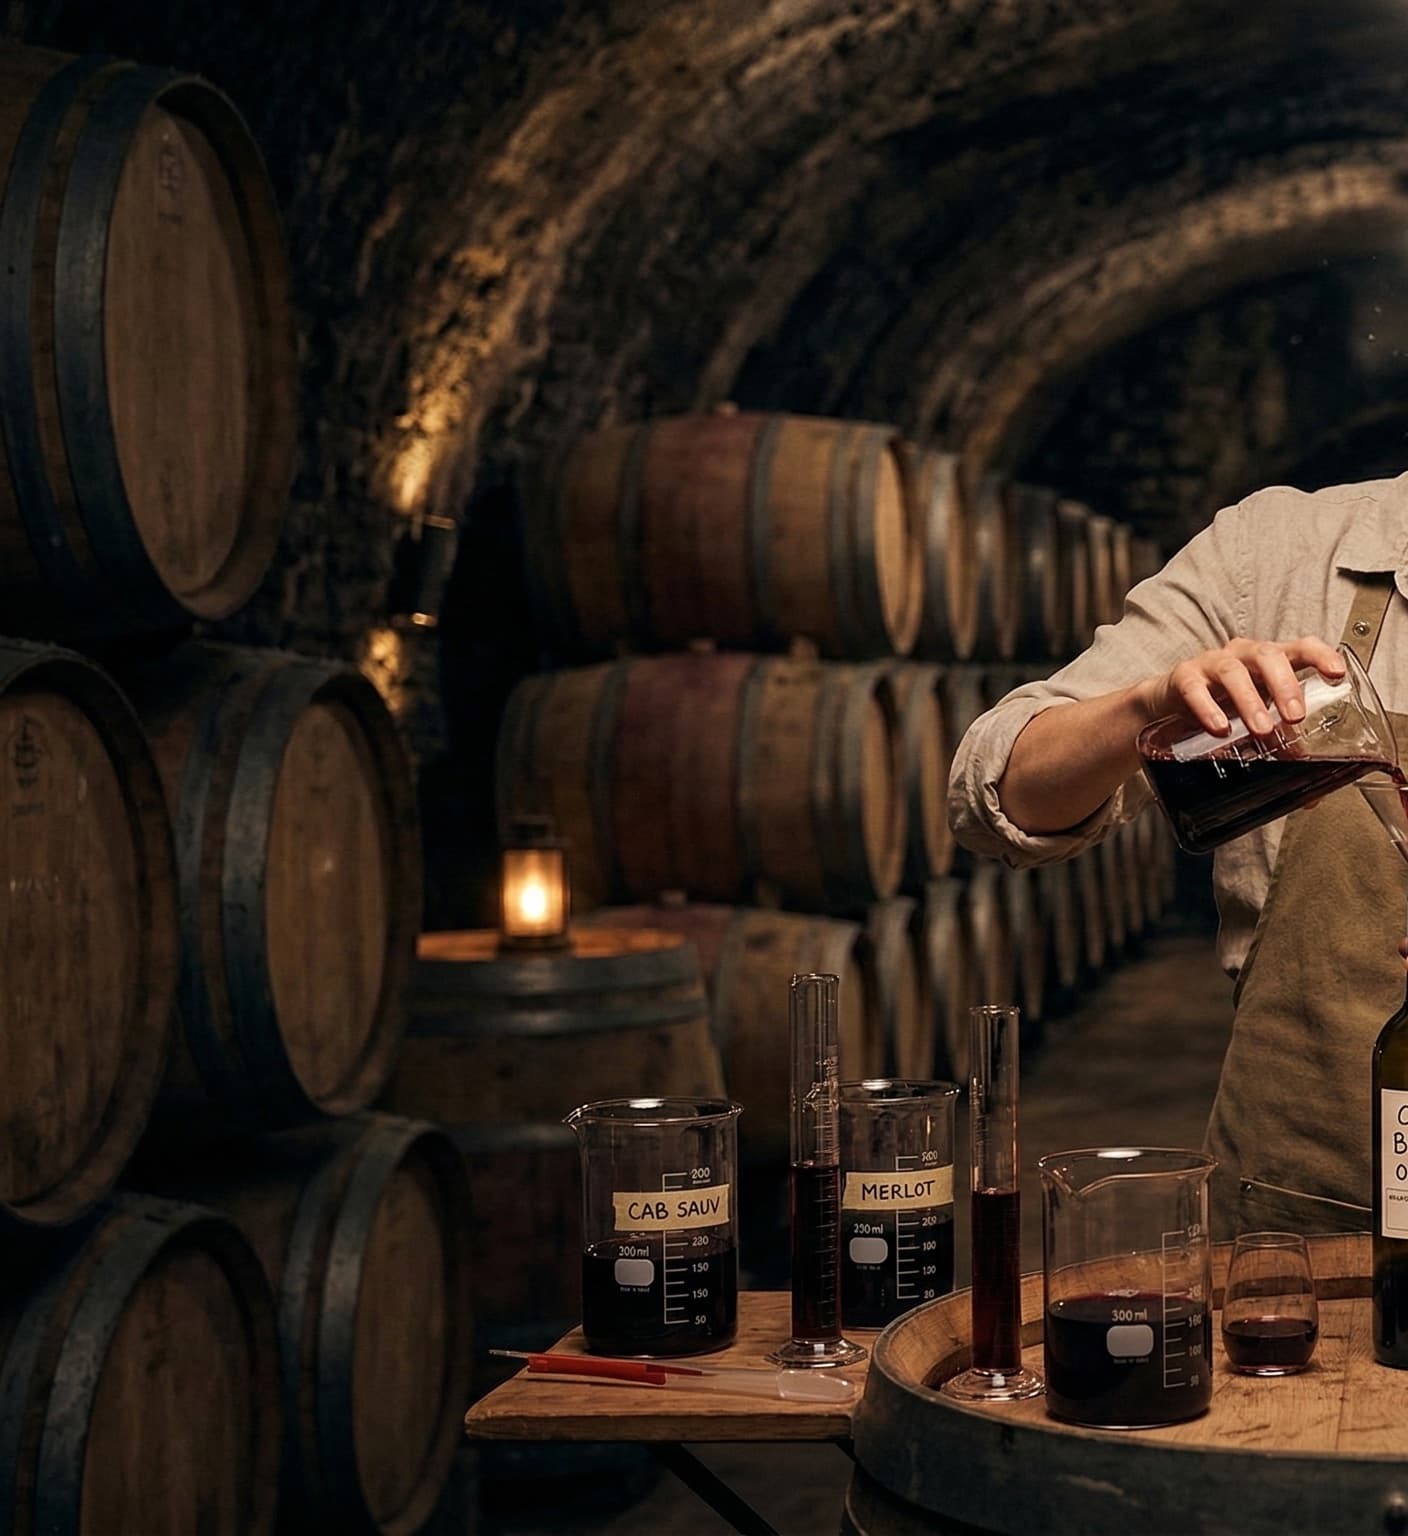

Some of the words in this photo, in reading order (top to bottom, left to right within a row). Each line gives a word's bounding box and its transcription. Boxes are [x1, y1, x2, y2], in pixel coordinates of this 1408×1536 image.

[862, 1180, 936, 1201] MERLOT
[628, 1202, 669, 1220] CAB
[677, 1196, 720, 1218] SAUV
